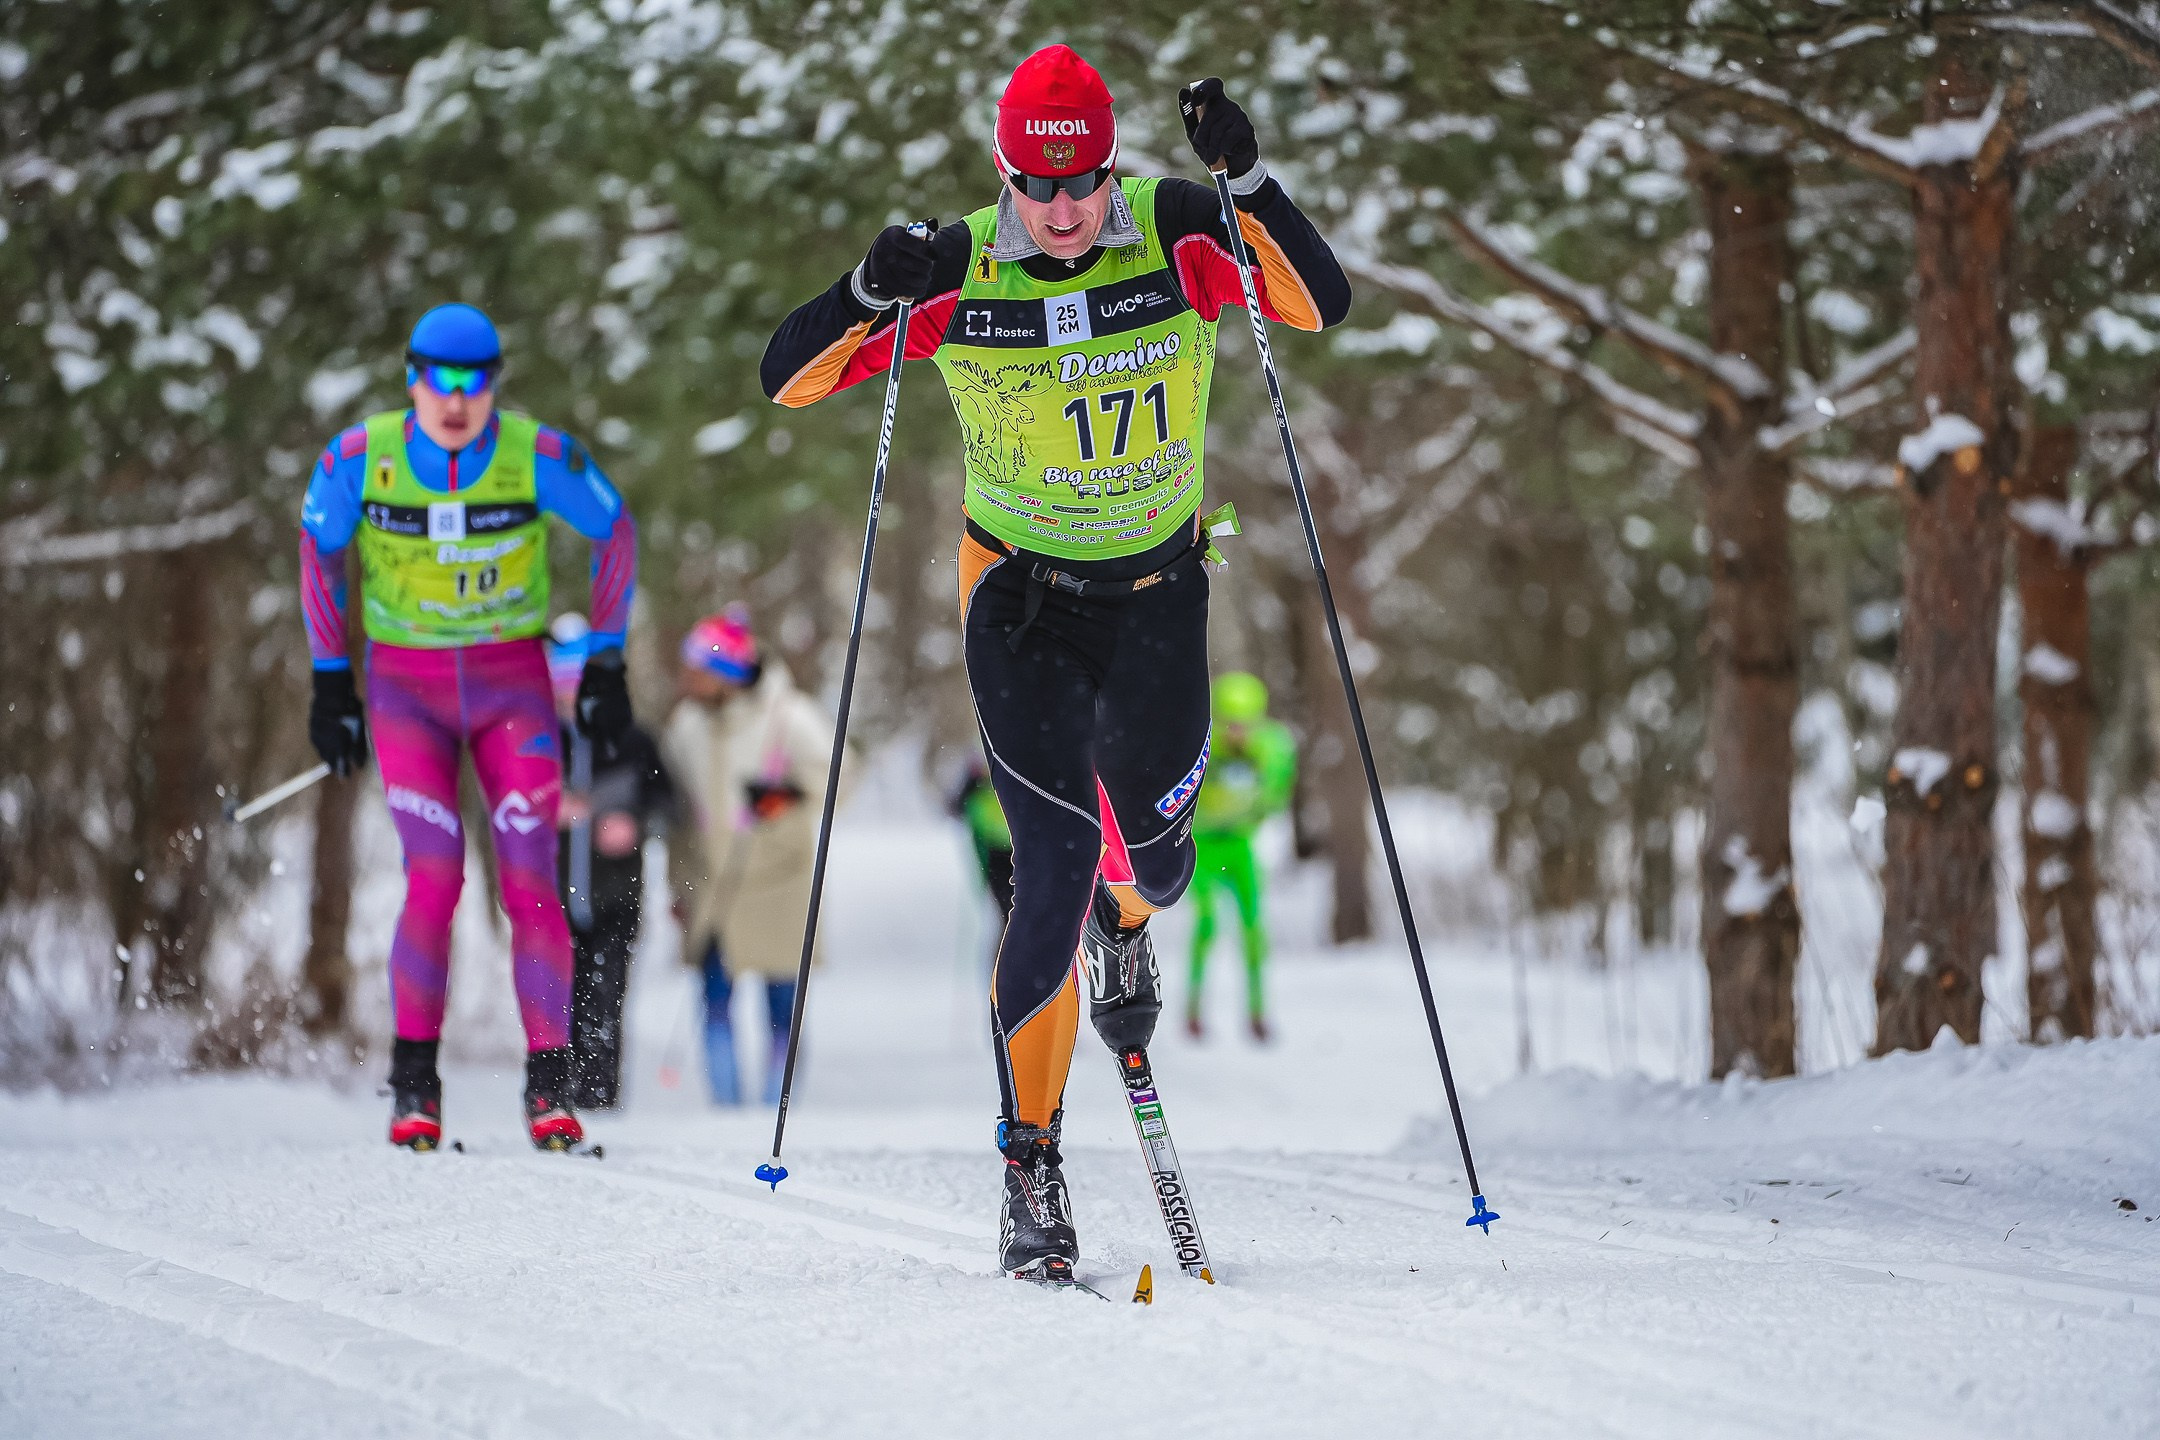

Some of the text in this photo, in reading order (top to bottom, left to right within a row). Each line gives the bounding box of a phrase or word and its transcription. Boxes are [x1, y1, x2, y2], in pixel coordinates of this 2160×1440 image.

[1025, 119, 1090, 136] LUKOIL
[1115, 200, 1129, 225] CRAFT
[1056, 303, 1078, 322] 25
[1100, 300, 1136, 318] UAC
[995, 326, 1036, 338] Rostec
[1058, 320, 1080, 335] KM
[1057, 331, 1181, 383] Demino
[1061, 380, 1171, 463] 171
[1044, 437, 1188, 488] Big race of big
[1109, 488, 1168, 515] greenworks
[1160, 477, 1195, 513] MADSHUS
[1032, 514, 1060, 526] PRO
[1086, 516, 1138, 529] NORDSKI
[1028, 525, 1106, 543] MOAXSPORT
[456, 565, 499, 599] 10
[1151, 1170, 1205, 1271] ROSSIGNOL
